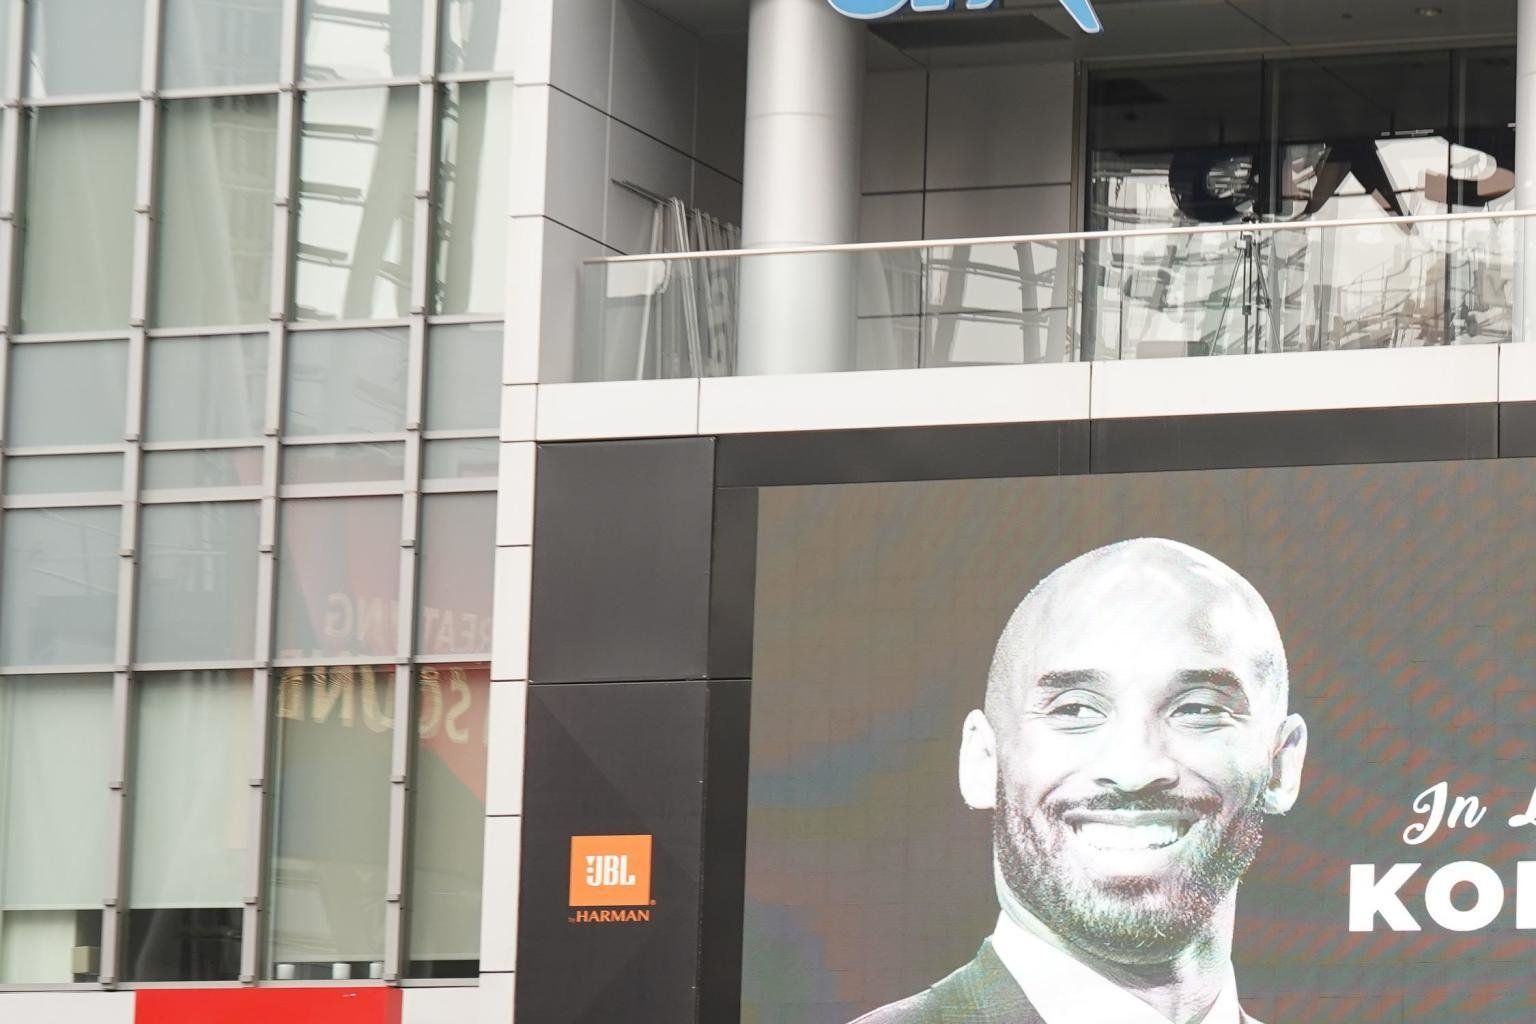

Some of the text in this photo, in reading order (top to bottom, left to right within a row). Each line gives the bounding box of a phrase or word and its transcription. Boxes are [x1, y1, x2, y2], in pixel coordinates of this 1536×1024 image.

[1402, 781, 1487, 845] In
[585, 855, 636, 887] JBL
[576, 909, 651, 923] HARMAN
